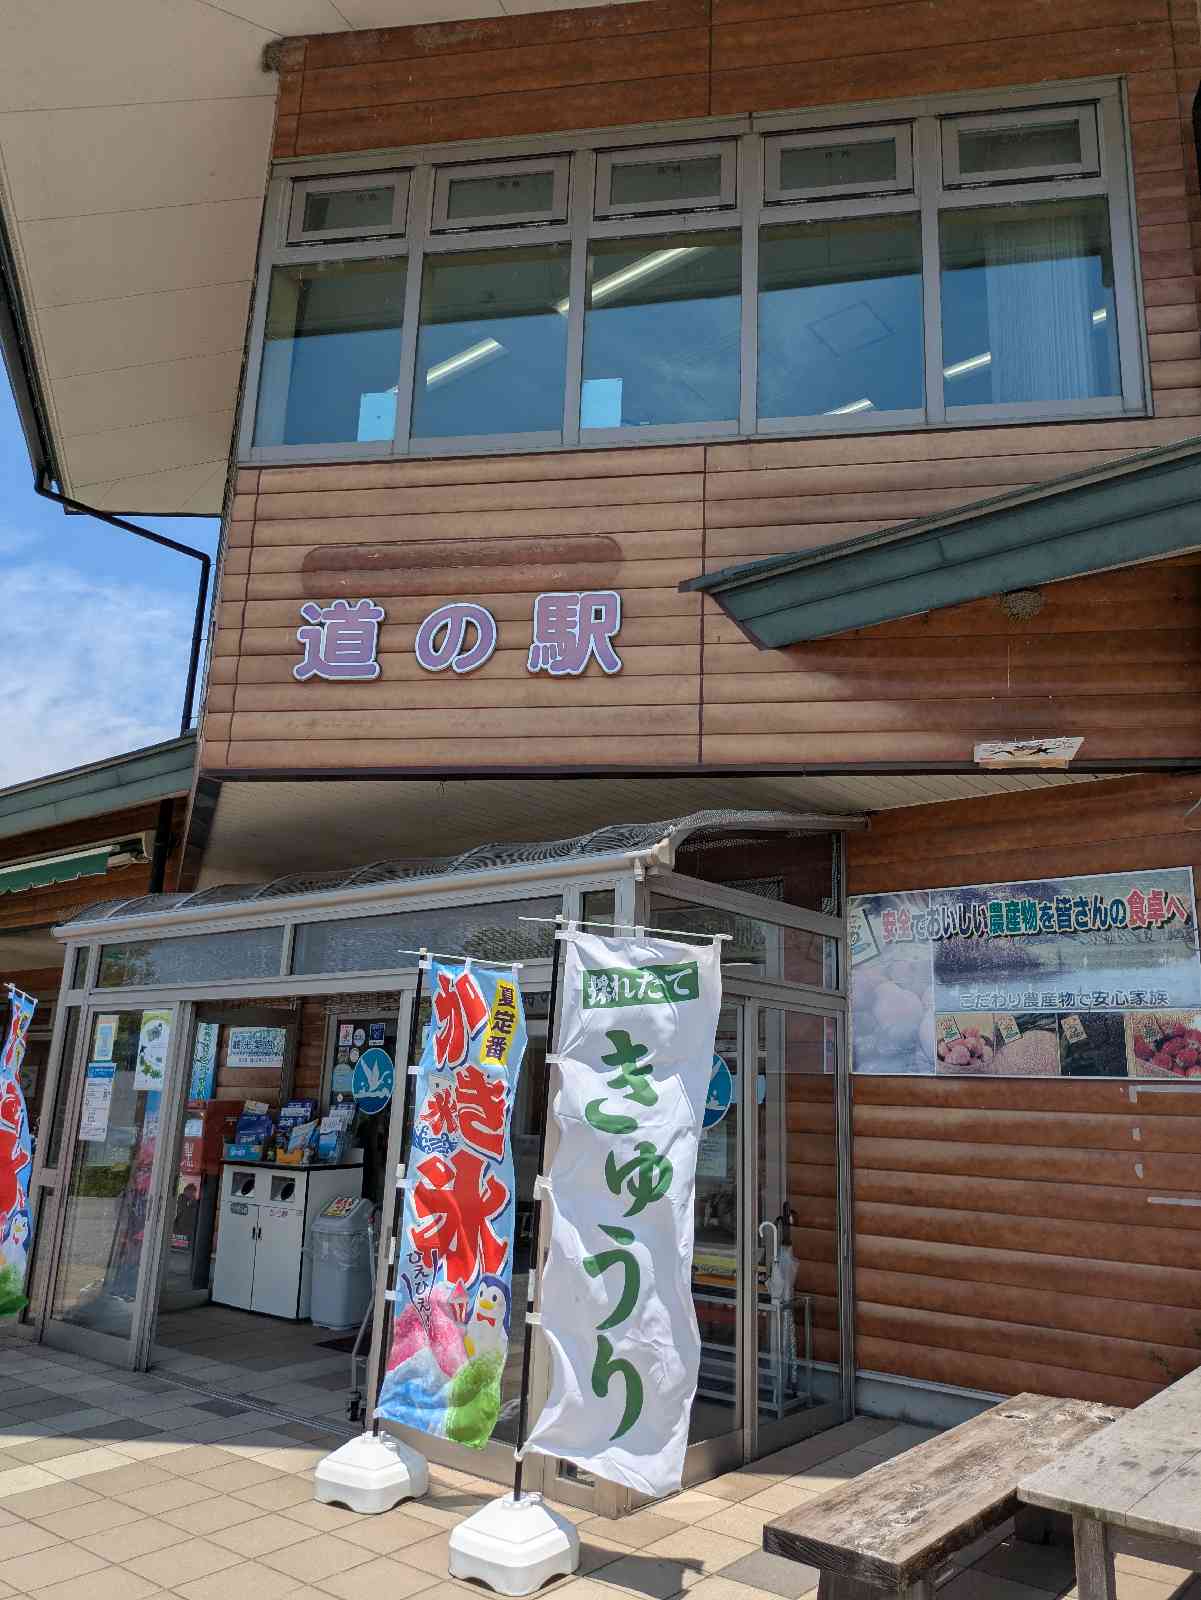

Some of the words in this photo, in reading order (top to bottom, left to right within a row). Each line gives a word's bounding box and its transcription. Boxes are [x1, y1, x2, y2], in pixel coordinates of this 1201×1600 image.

[293, 590, 622, 682] 道の駅
[881, 888, 1189, 943] 安全でおいしい農産物を皆さんの食卓へ
[485, 983, 516, 1062] 夏定番
[586, 966, 695, 1006] 採れたて
[959, 989, 1169, 1009] こだわり農産物で安心家族
[407, 971, 511, 1286] かき氷
[584, 1028, 673, 1441] きゅうり
